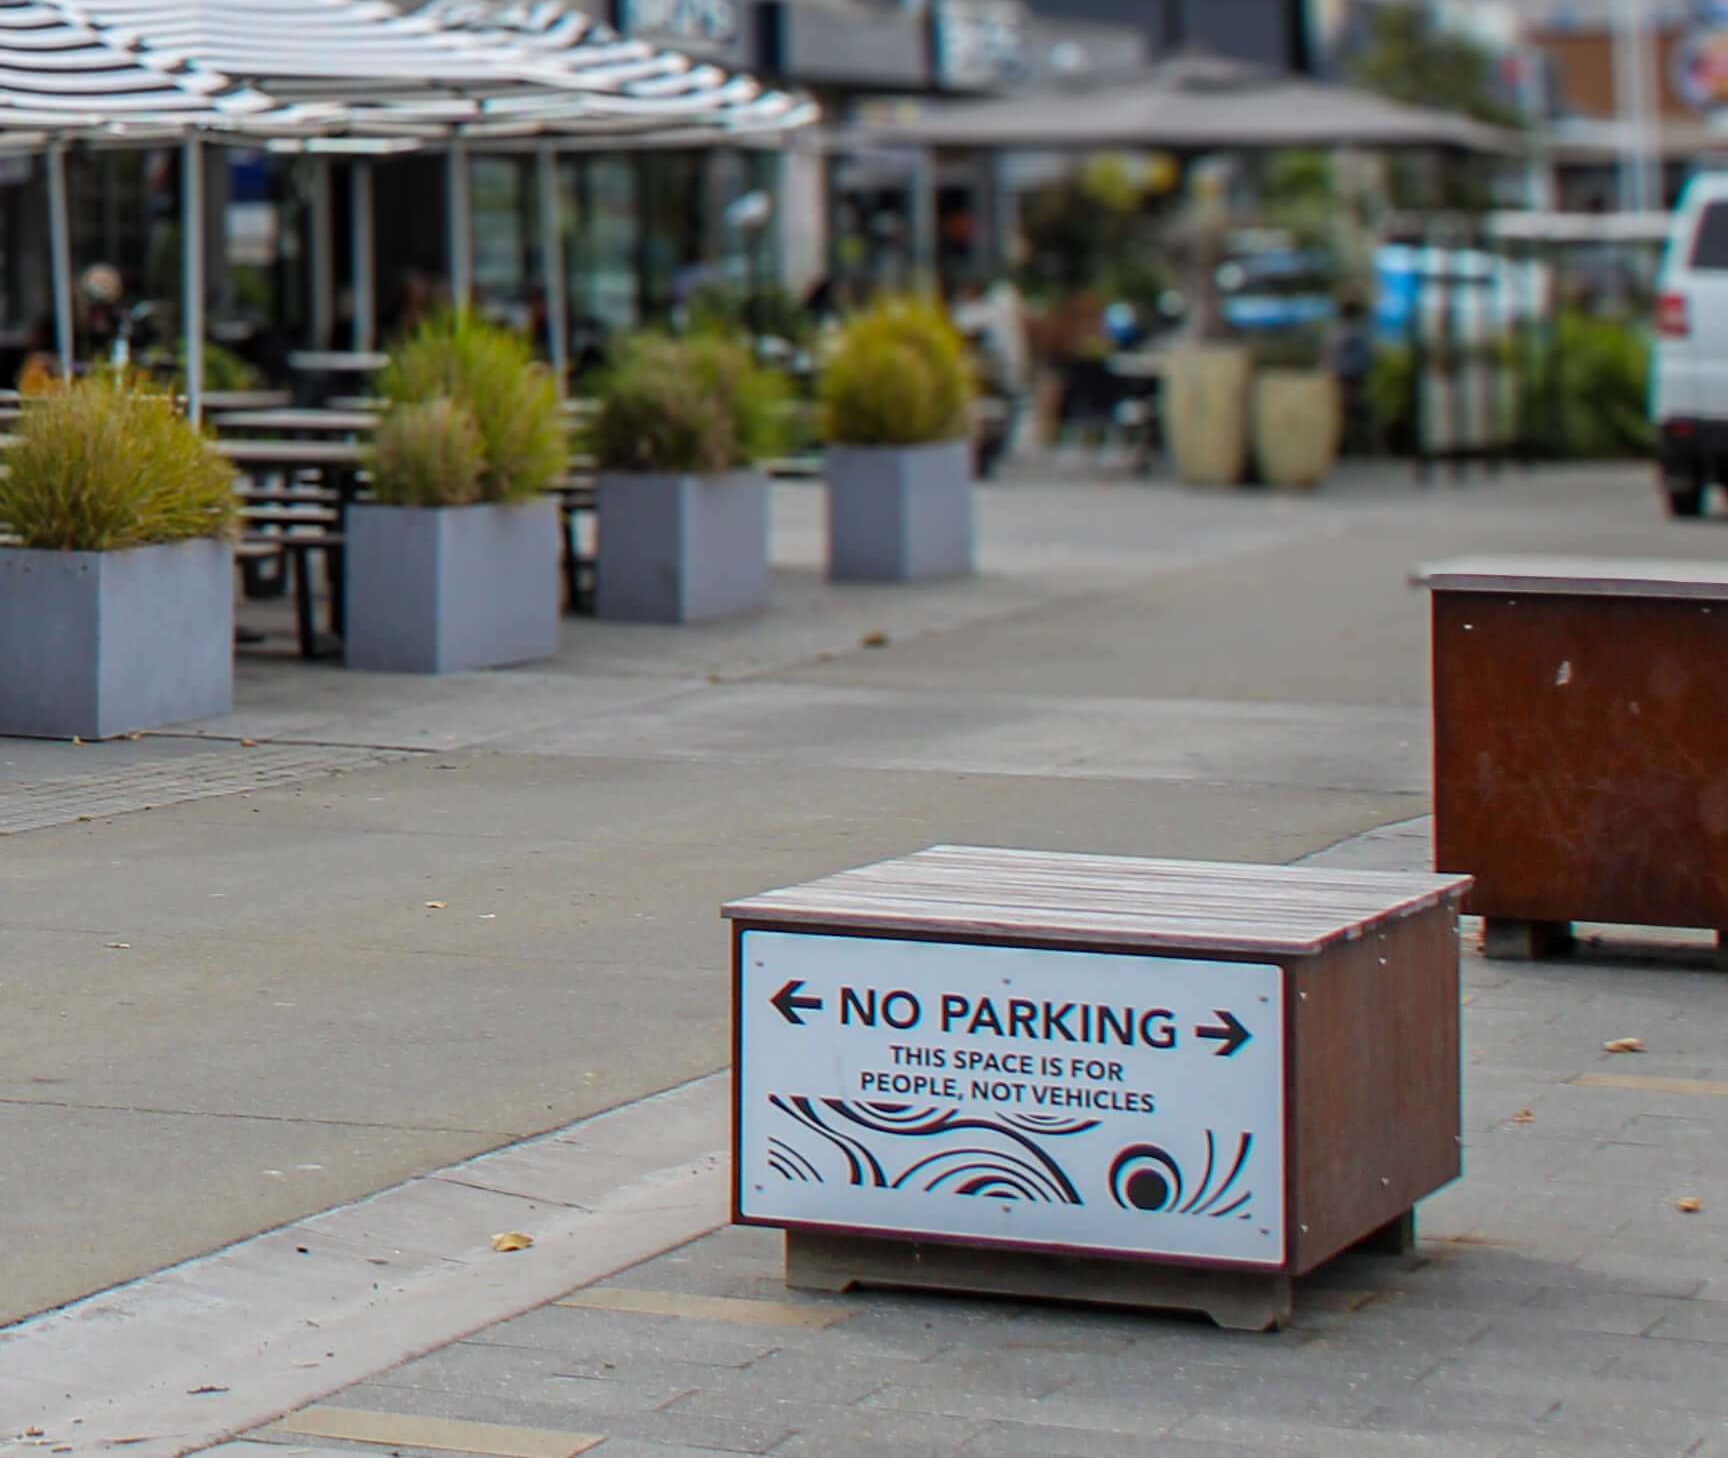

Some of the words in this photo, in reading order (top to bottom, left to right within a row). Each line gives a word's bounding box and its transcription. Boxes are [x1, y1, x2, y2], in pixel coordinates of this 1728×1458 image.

[839, 986, 923, 1030] NO
[940, 993, 1179, 1049] PARKING
[889, 1044, 947, 1068] THIS
[953, 1049, 1034, 1075] SPACE
[1041, 1056, 1064, 1076] IS
[1071, 1058, 1125, 1082] FOR
[859, 1071, 965, 1101] PEOPLE,
[970, 1080, 1028, 1104] NOT
[1030, 1085, 1156, 1114] VEHICLES
